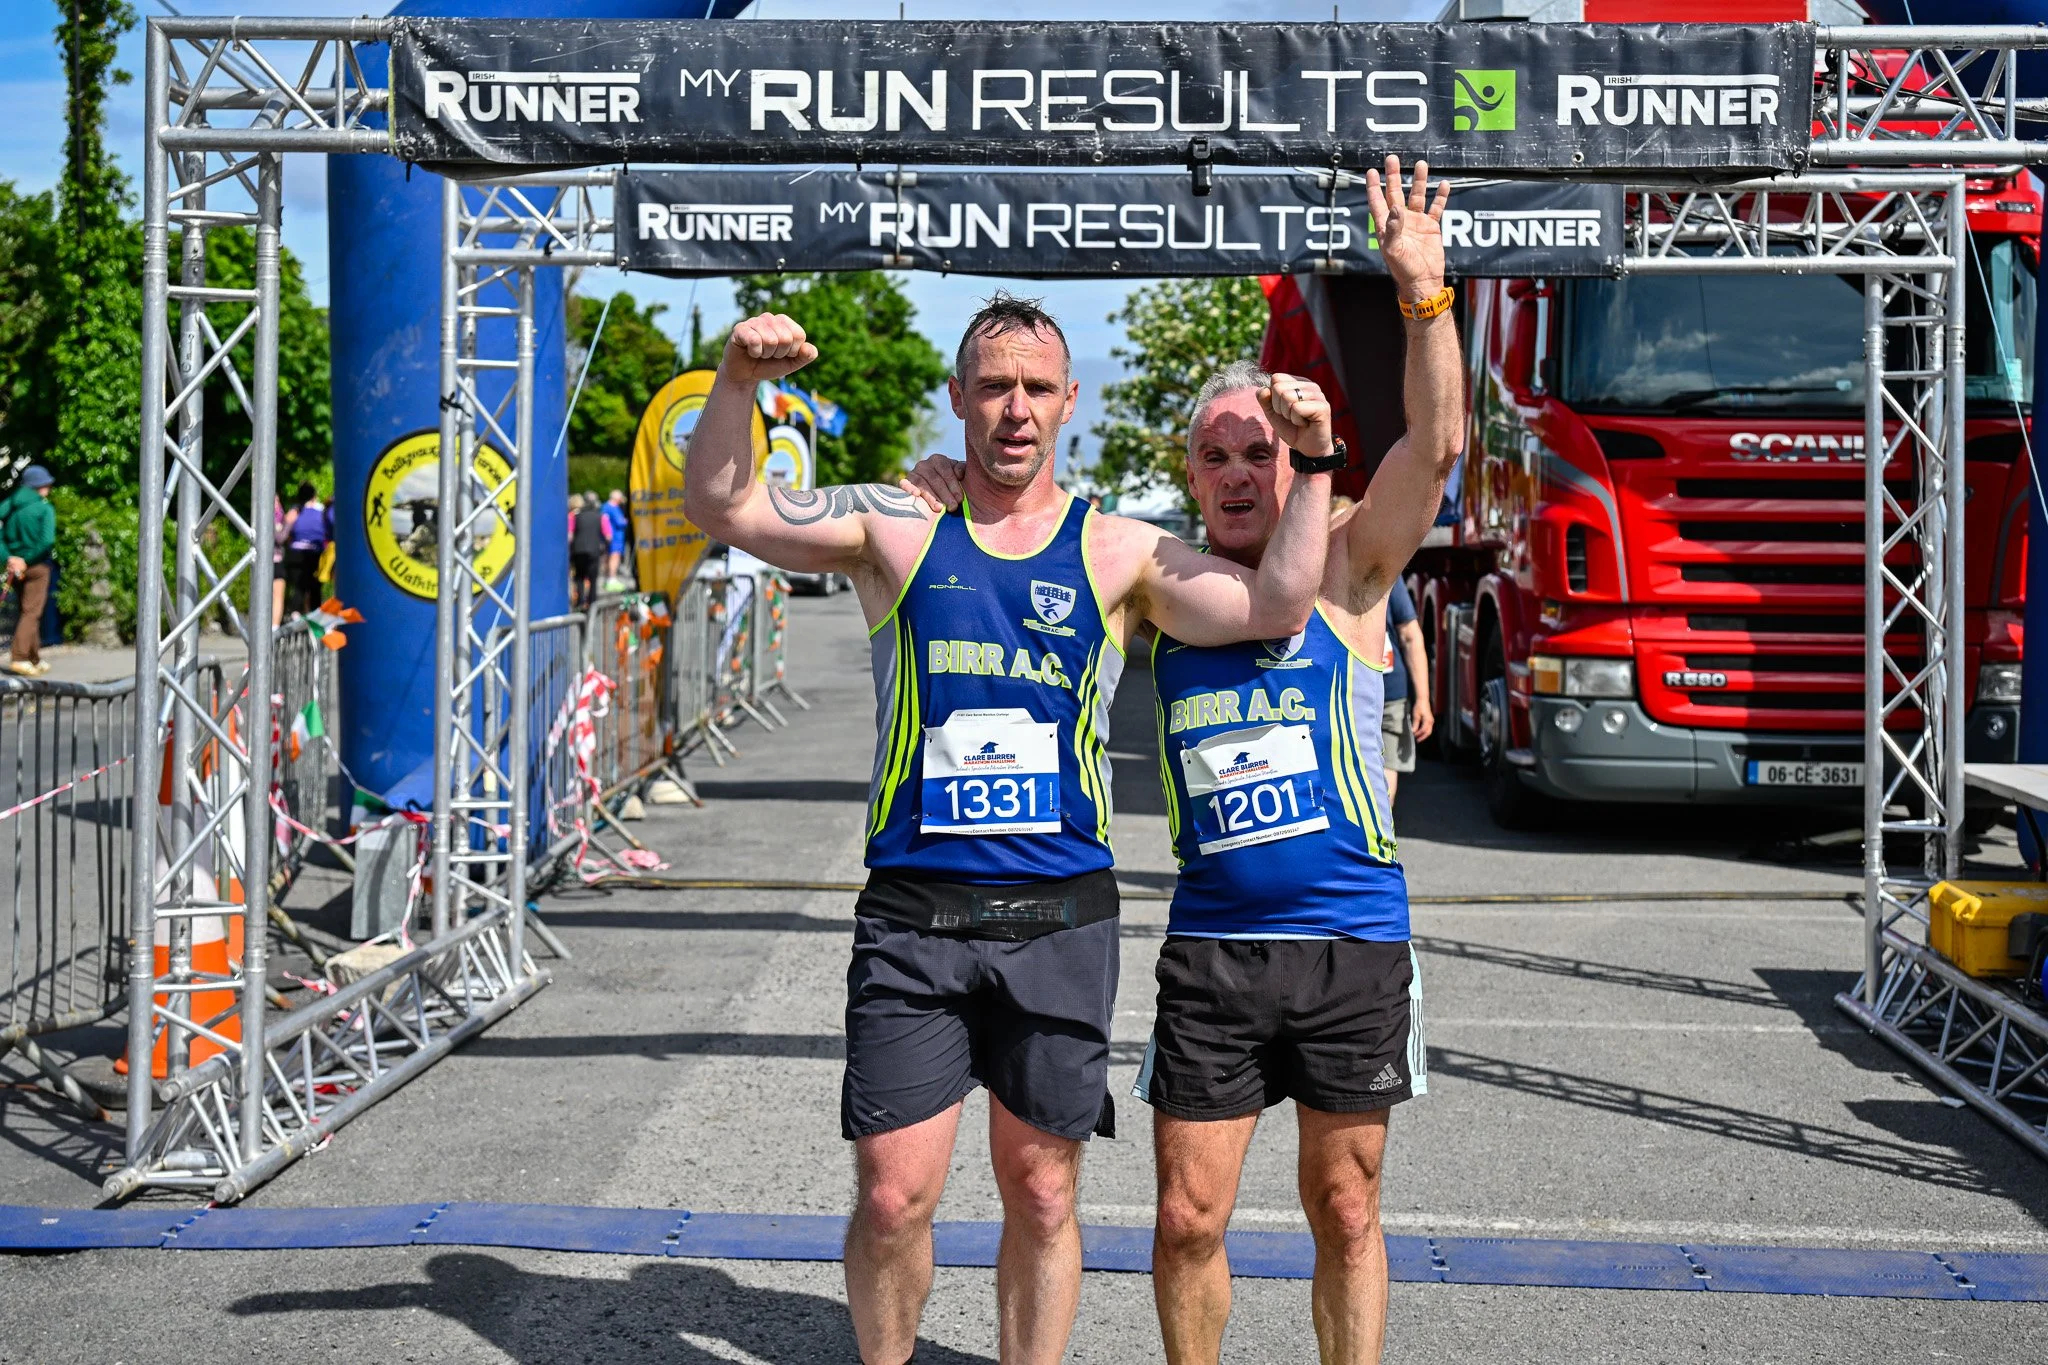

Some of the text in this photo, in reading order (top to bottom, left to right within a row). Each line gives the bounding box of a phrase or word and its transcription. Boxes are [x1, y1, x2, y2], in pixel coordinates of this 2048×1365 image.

[424, 71, 640, 123] RUNNER
[680, 68, 1428, 132] MY RUN RESULTS
[1557, 74, 1780, 126] RUNNER
[1608, 76, 1632, 84] IRISH
[638, 202, 793, 241] RUNNER
[820, 202, 1351, 250] MY RUN RESULTS
[1441, 209, 1601, 248] RUNNER
[929, 640, 1072, 689] BIRR A.C.
[1665, 672, 1681, 687] R
[1170, 687, 1316, 734] BIRR A.C.
[1218, 759, 1268, 775] CLARE BURREN
[1768, 766, 1857, 784] 06-CE-3631
[944, 778, 1036, 820] 1331
[1208, 779, 1299, 834] 1201
[1369, 1076, 1402, 1091] adidas
